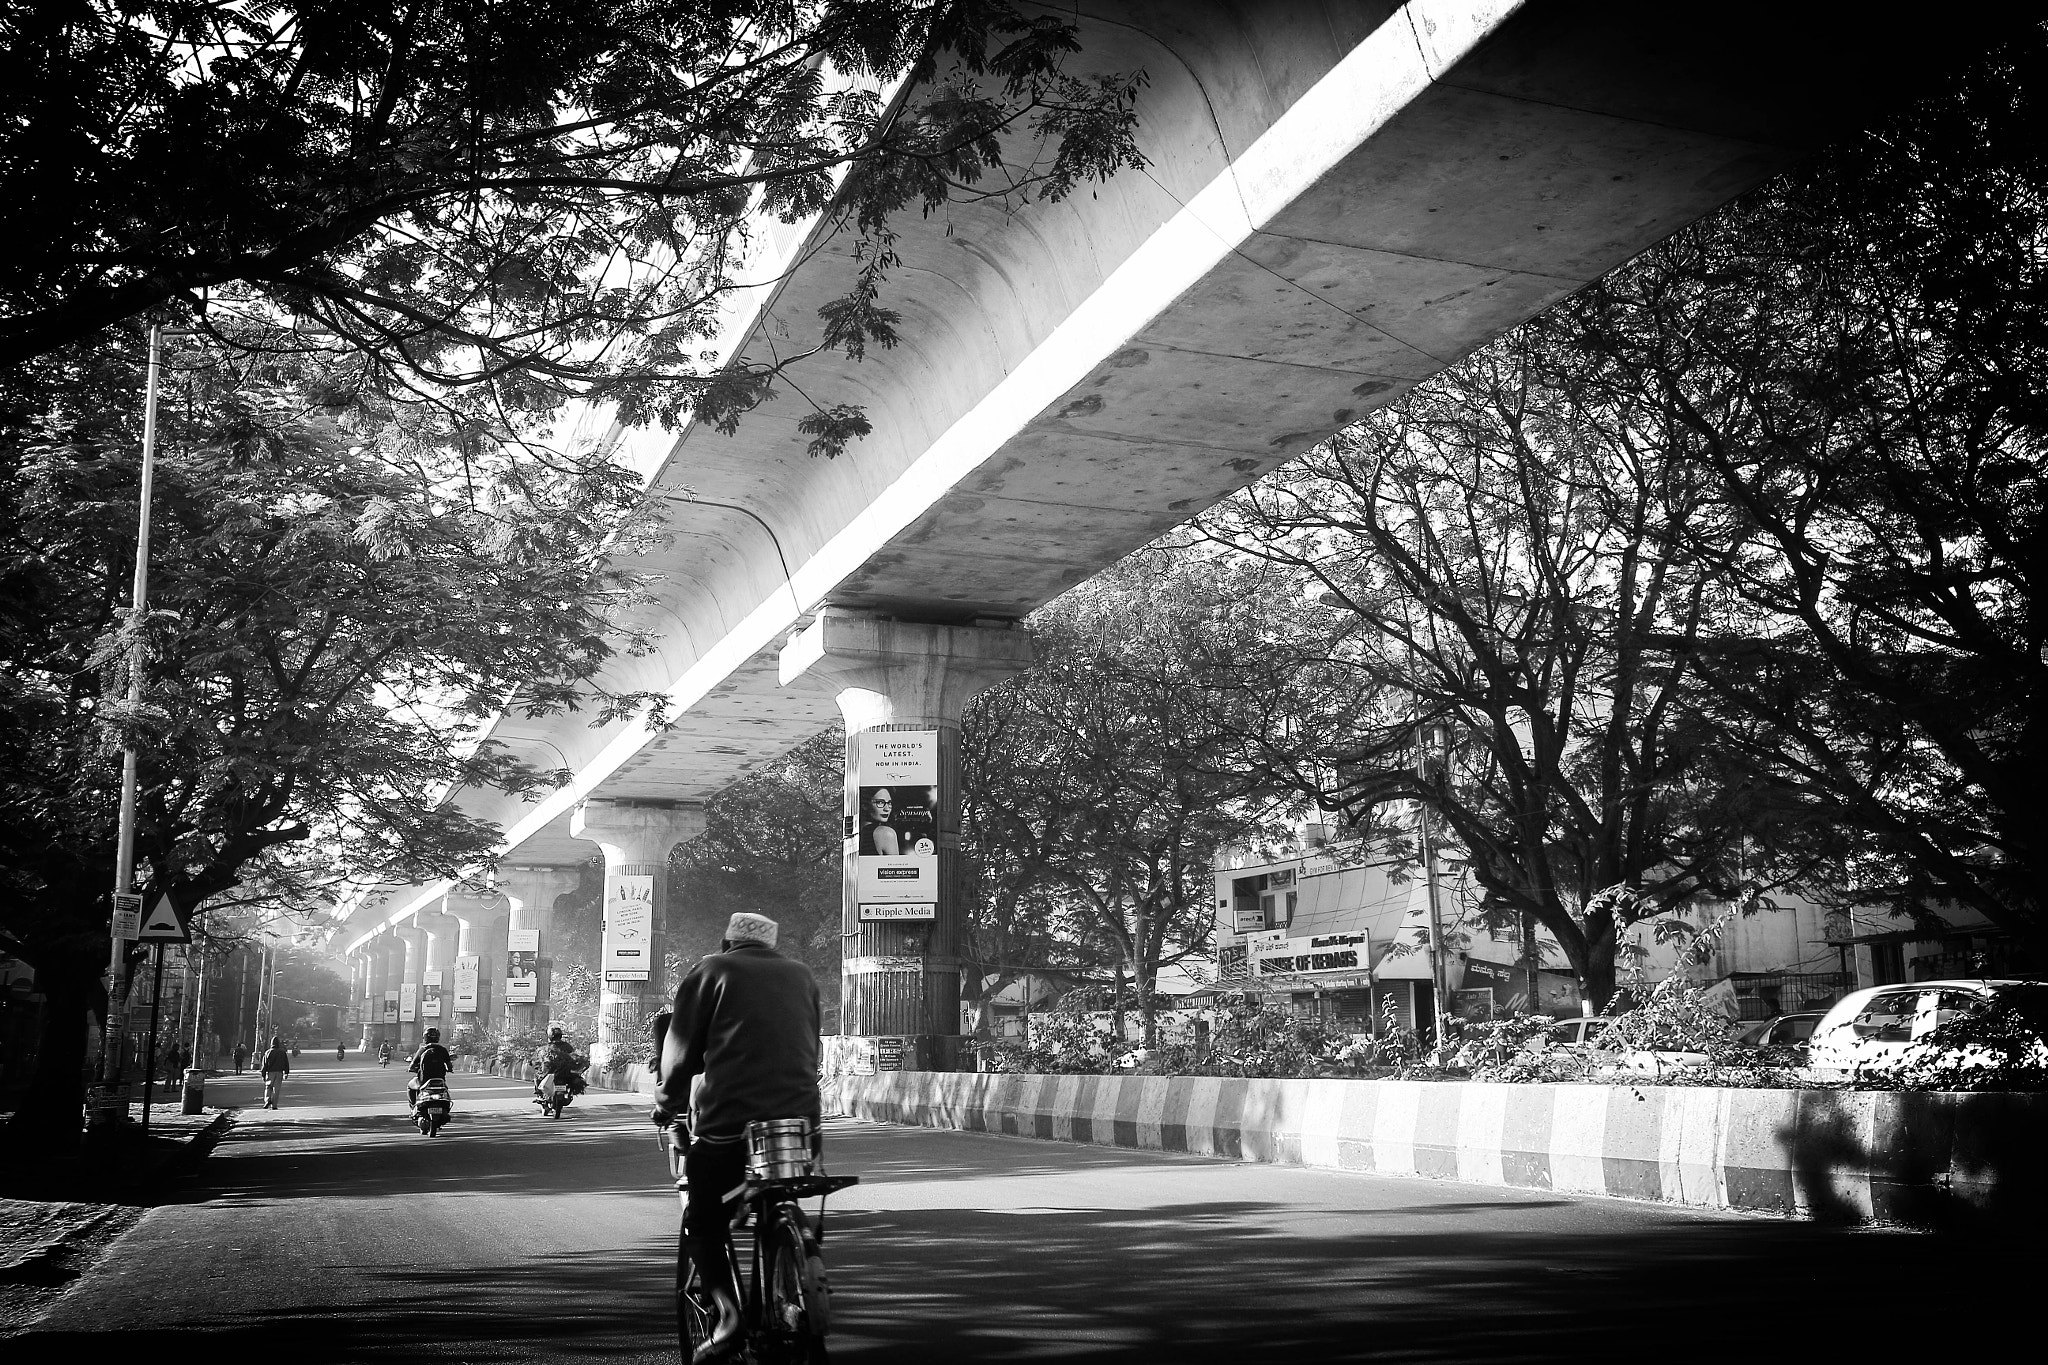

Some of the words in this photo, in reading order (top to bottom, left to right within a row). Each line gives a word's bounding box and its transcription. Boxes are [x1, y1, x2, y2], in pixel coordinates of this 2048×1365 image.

[875, 907, 902, 917] Ripple
[905, 907, 931, 916] Media
[1295, 954, 1311, 971] OF
[1311, 950, 1358, 970] KEBABS
